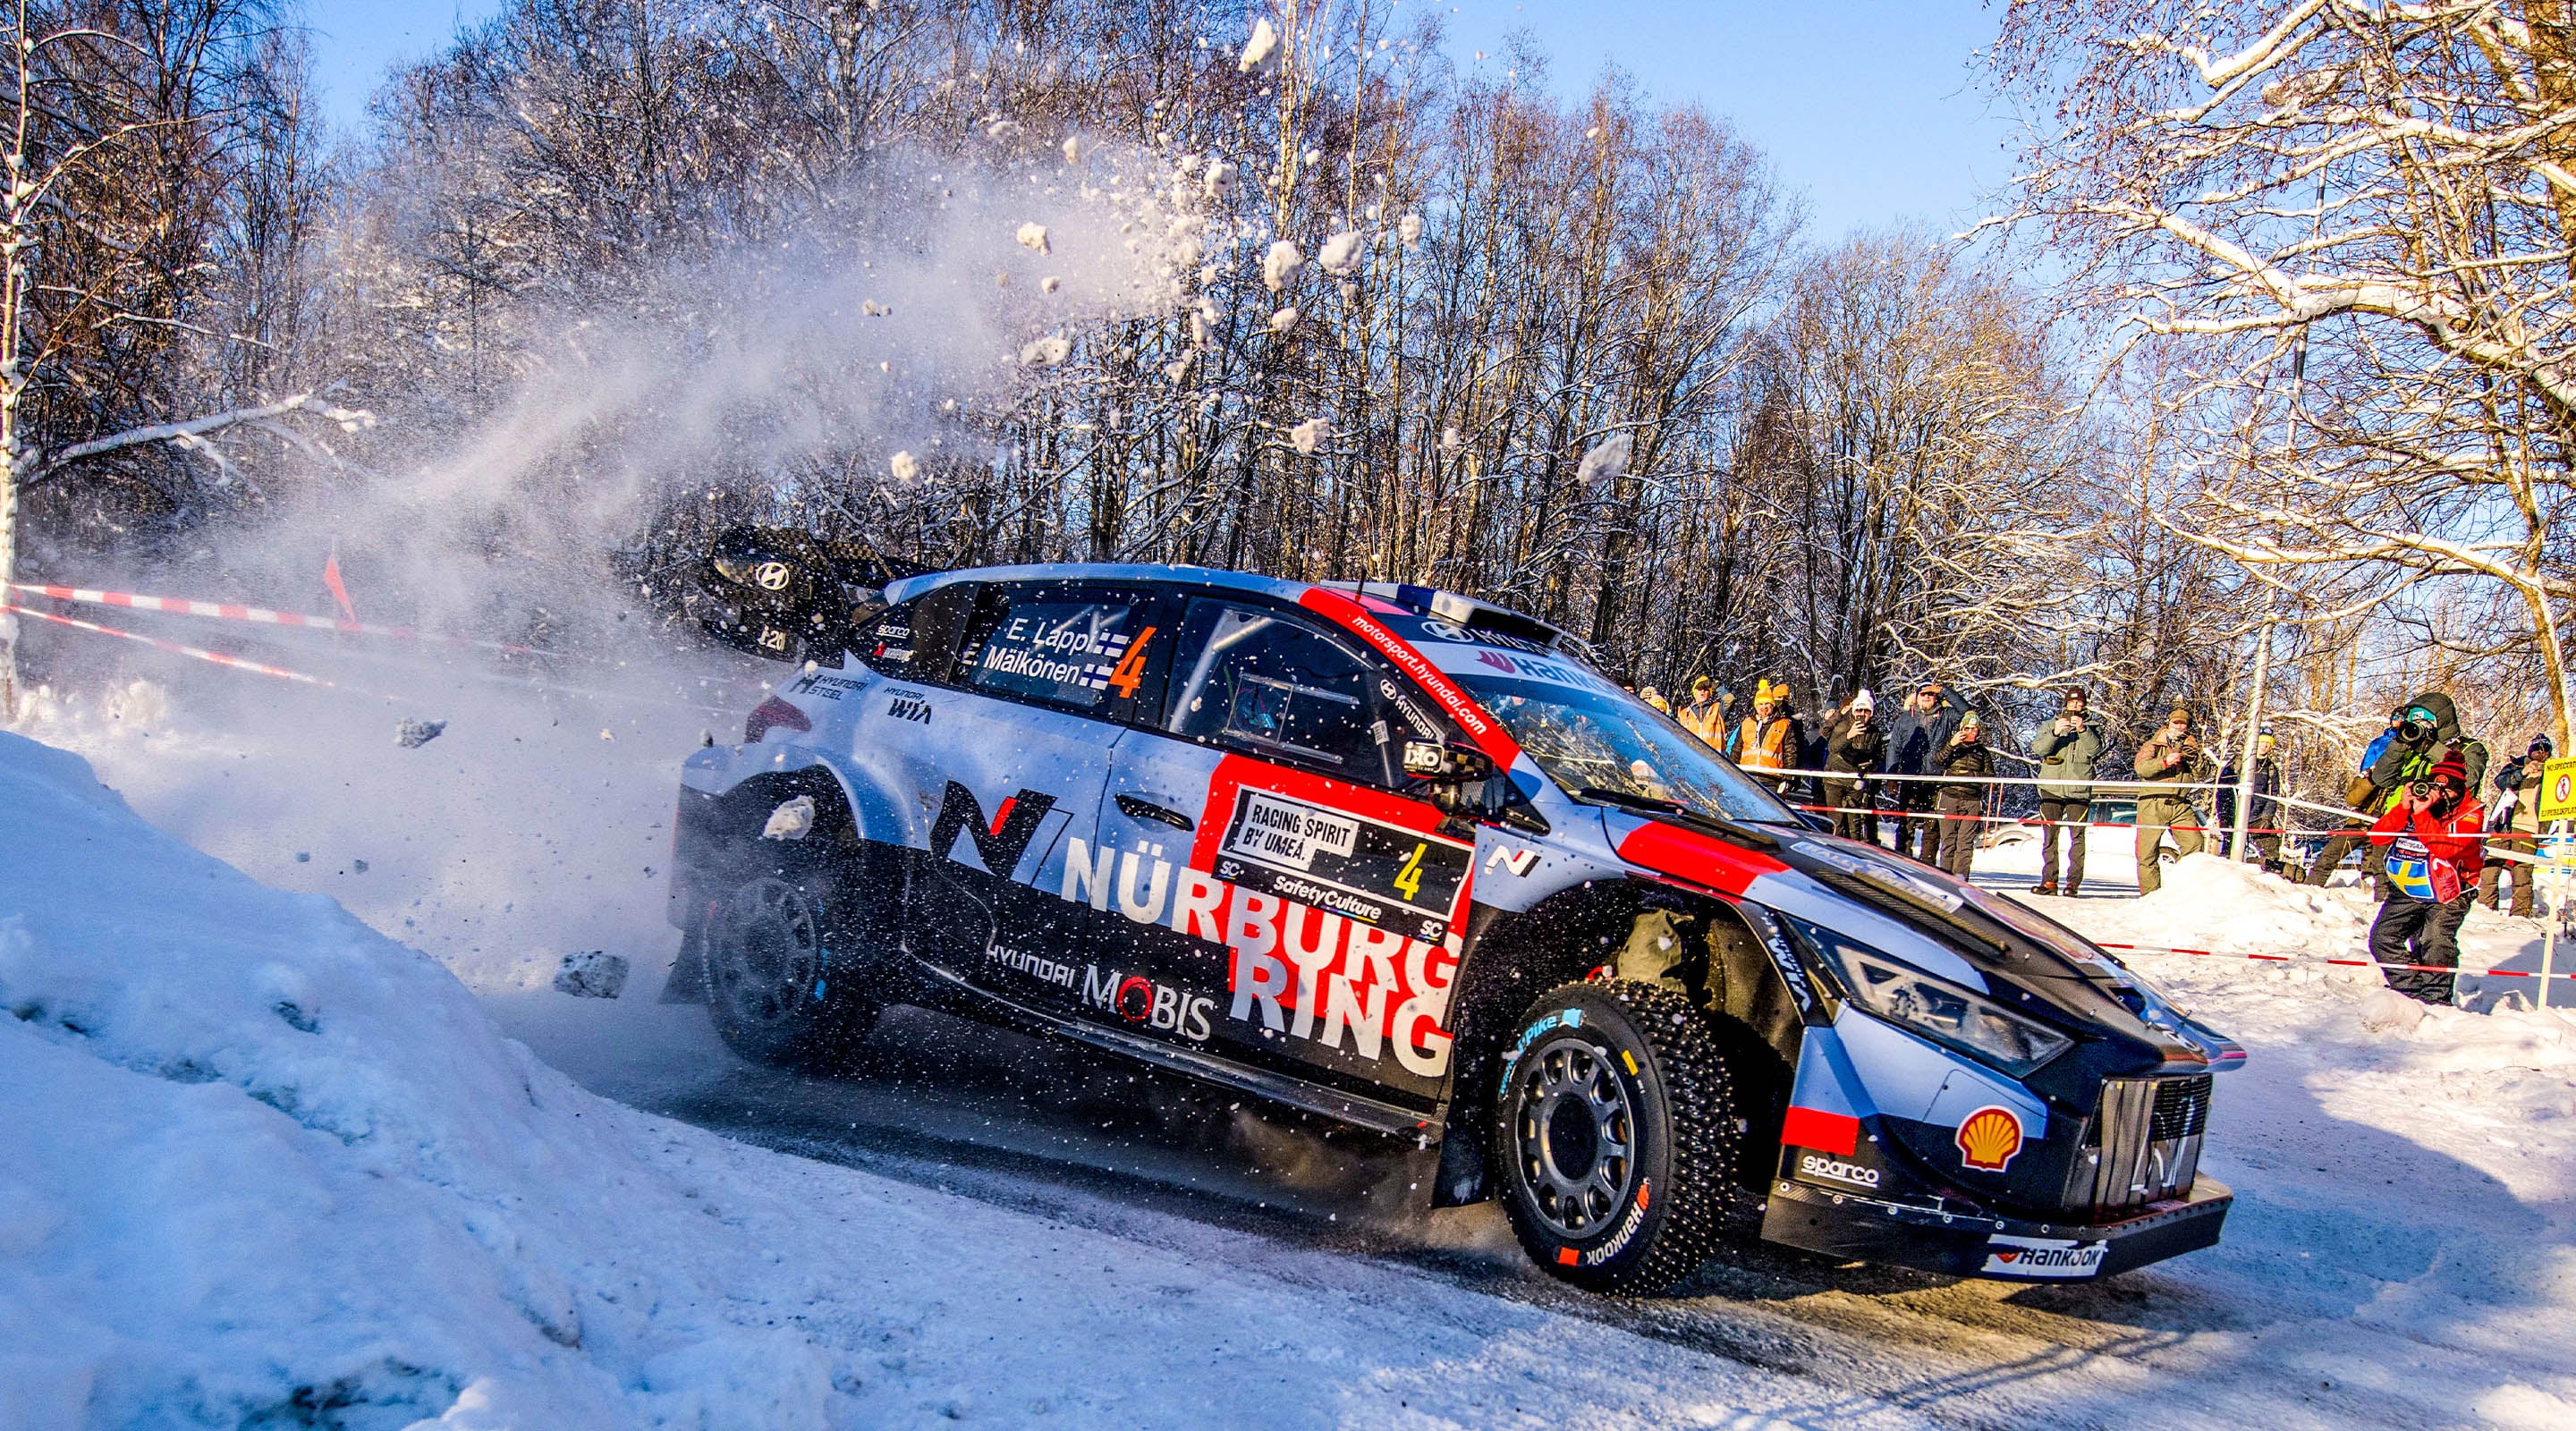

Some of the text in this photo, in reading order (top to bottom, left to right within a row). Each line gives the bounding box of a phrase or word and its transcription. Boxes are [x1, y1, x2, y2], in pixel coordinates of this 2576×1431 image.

[876, 624, 911, 639] sparco
[1006, 617, 1029, 642] E.
[962, 641, 1080, 684] E. Mälkönen
[1109, 626, 1157, 699] 4
[1352, 615, 1487, 735] motorsport.hyundai.com
[809, 686, 843, 701] STEEL
[818, 675, 869, 692] HYUNDAI
[884, 687, 925, 699] HYUNDAI
[887, 699, 932, 724] WIA
[1395, 699, 1437, 740] HYUNDAI
[1242, 826, 1262, 847] BY
[1252, 804, 1351, 847] RACING SPIRIT
[1220, 860, 1240, 877] SC
[1394, 843, 1428, 902] 4
[1061, 837, 1462, 995] NÜRBURG
[1274, 876, 1382, 920] SafetyCulture
[1419, 920, 1443, 939] SC
[987, 944, 1215, 1041] HYUNDAI MOBIS
[1230, 945, 1454, 1078] RING
[1801, 1156, 1879, 1187] sparco
